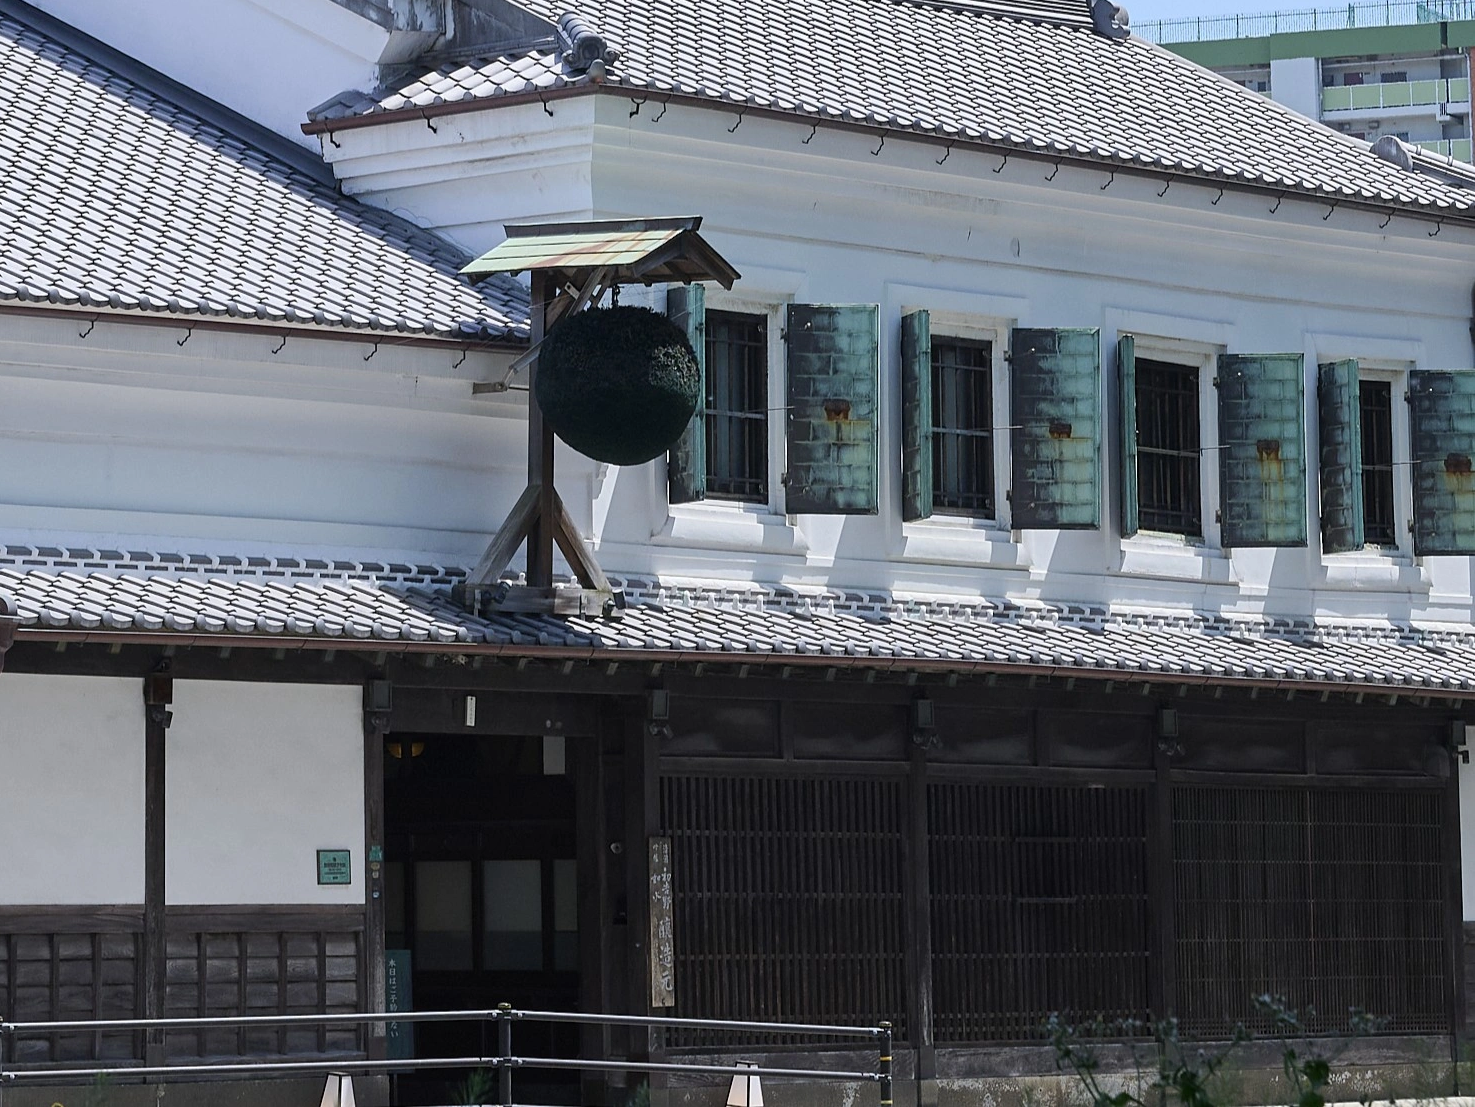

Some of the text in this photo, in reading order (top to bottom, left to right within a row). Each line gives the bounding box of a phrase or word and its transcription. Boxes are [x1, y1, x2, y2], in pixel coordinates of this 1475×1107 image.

[388, 958, 399, 1037] 本日はご予約ない
